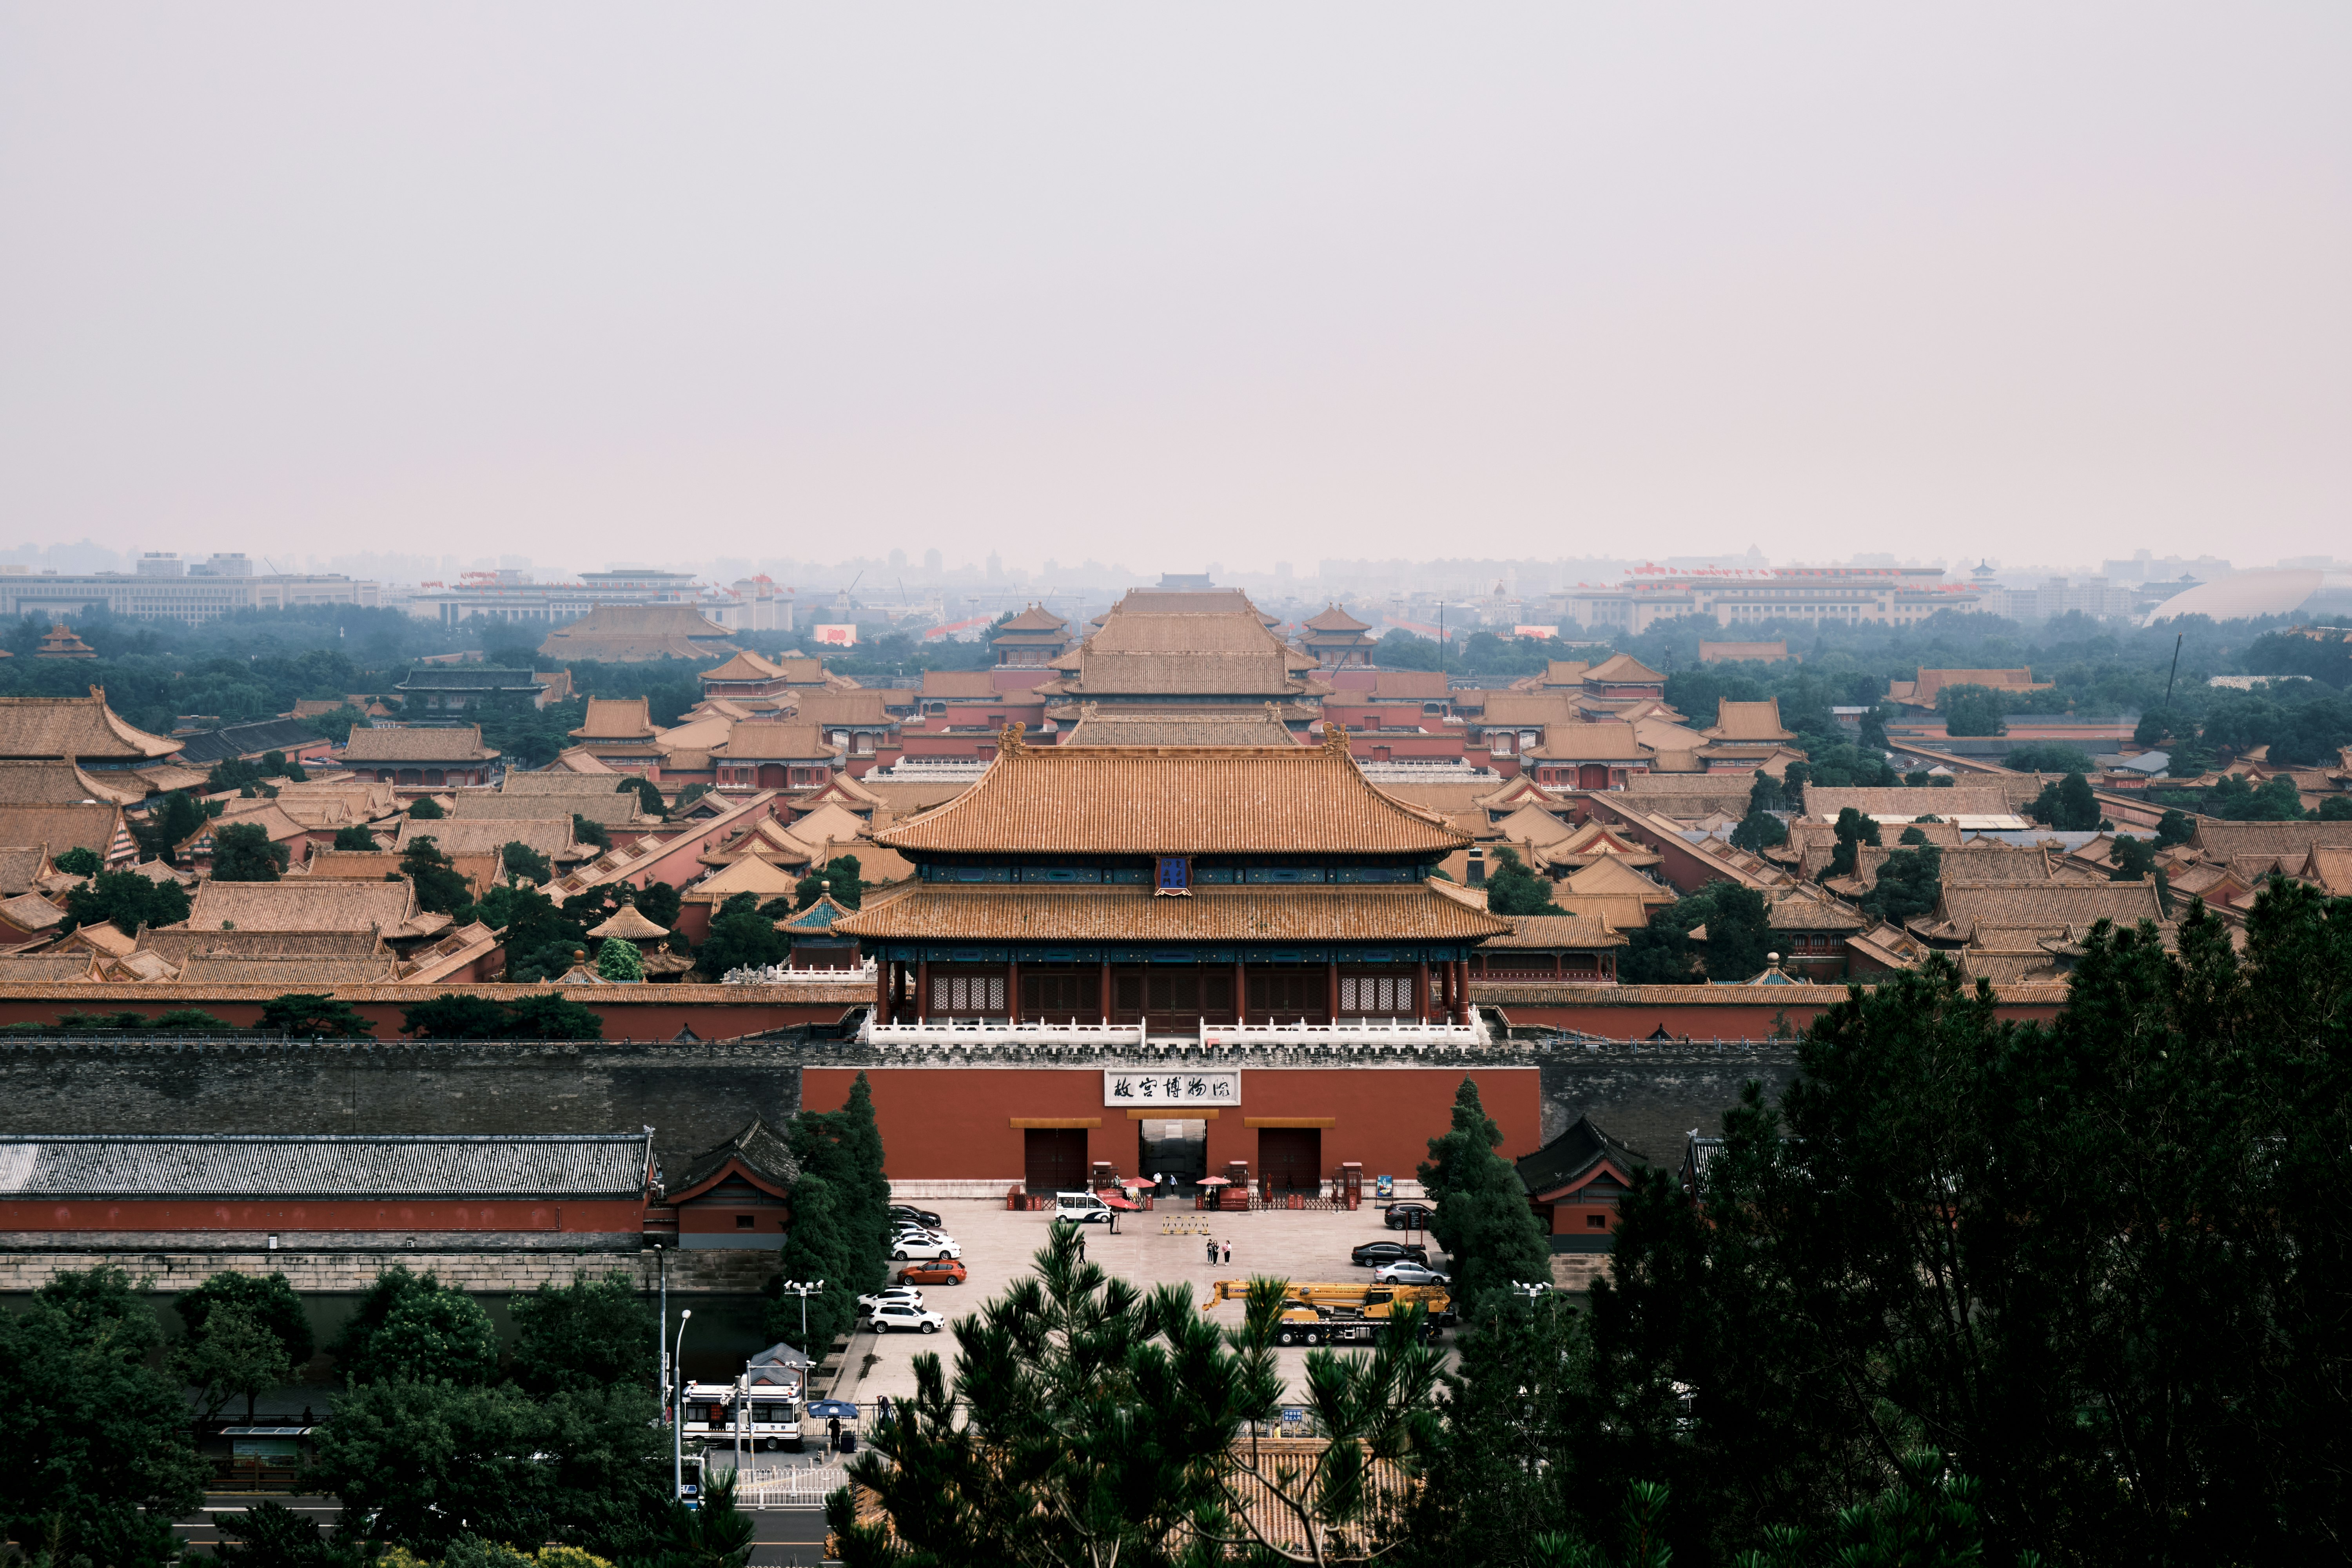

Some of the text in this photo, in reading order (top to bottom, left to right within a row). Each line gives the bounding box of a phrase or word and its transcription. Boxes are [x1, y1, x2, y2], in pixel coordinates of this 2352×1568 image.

[1114, 1077, 1230, 1098] 故宫博物院
